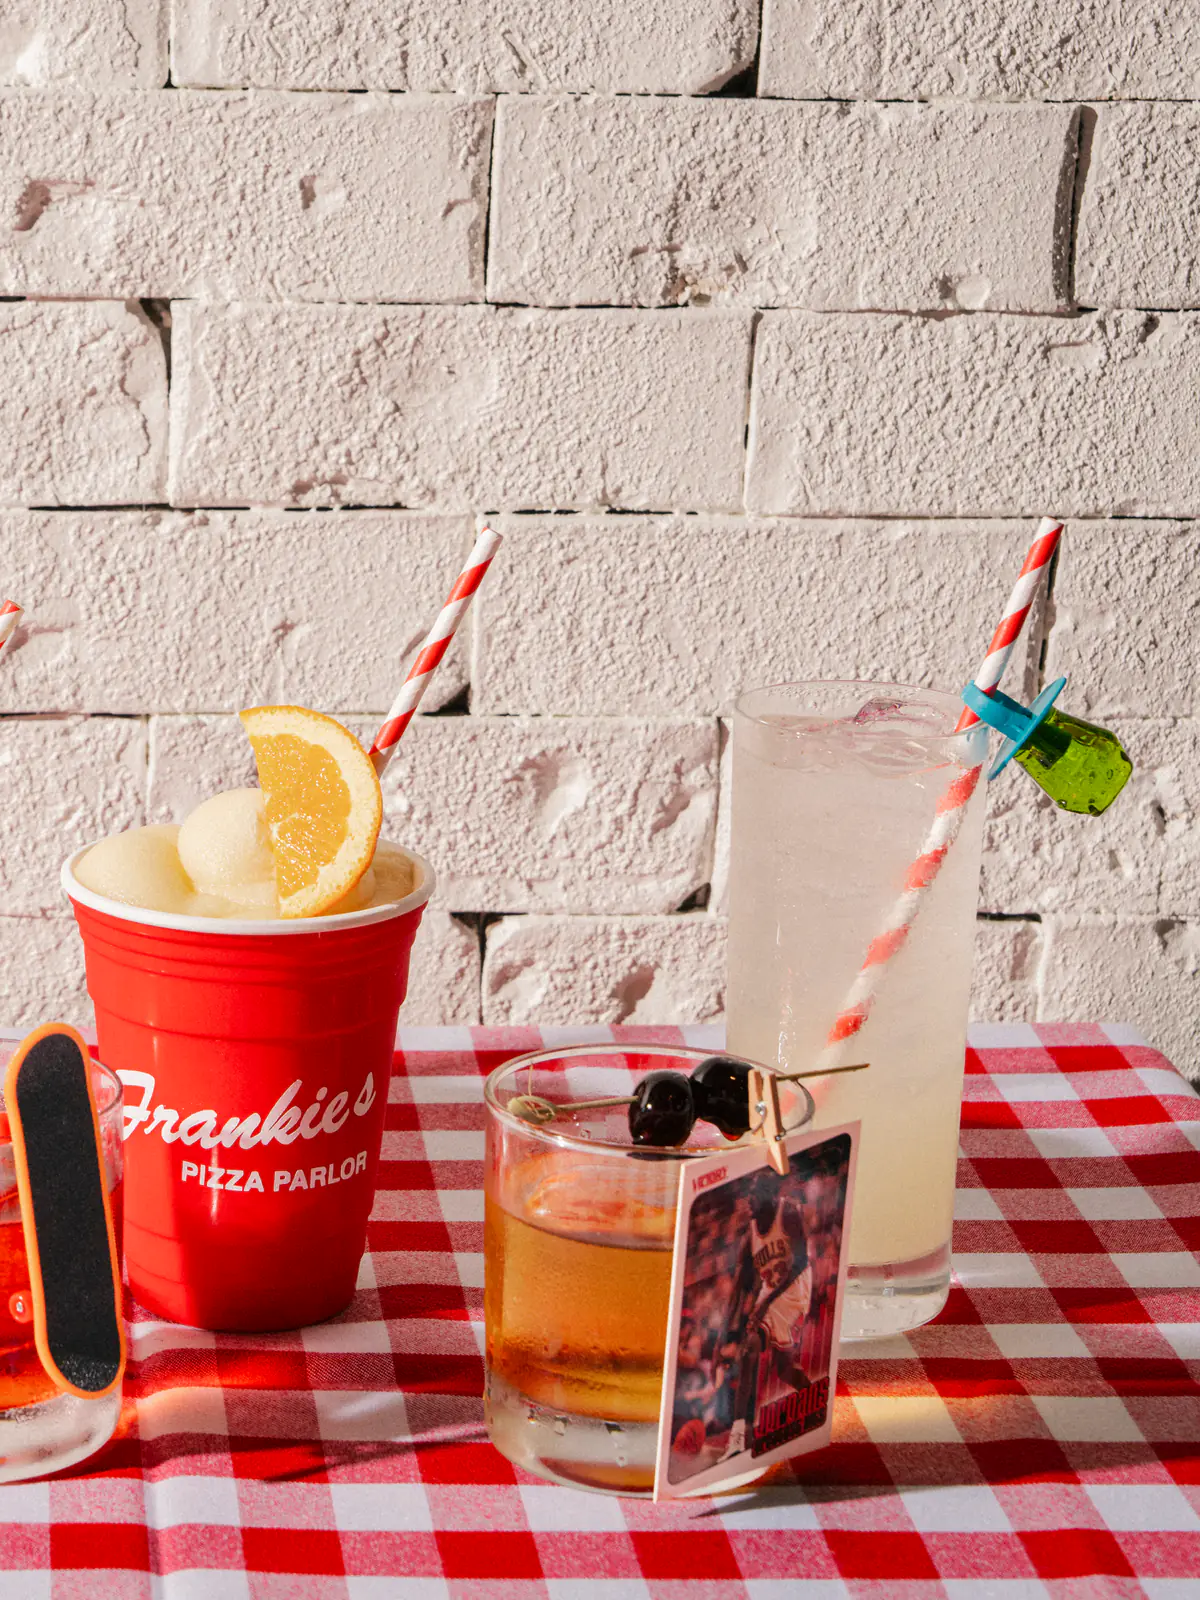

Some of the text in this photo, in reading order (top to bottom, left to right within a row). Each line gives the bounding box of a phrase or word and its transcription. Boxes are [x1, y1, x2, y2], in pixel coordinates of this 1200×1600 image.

[114, 1069, 377, 1150] Frankies
[181, 1150, 368, 1193] PIZZA PARLOR
